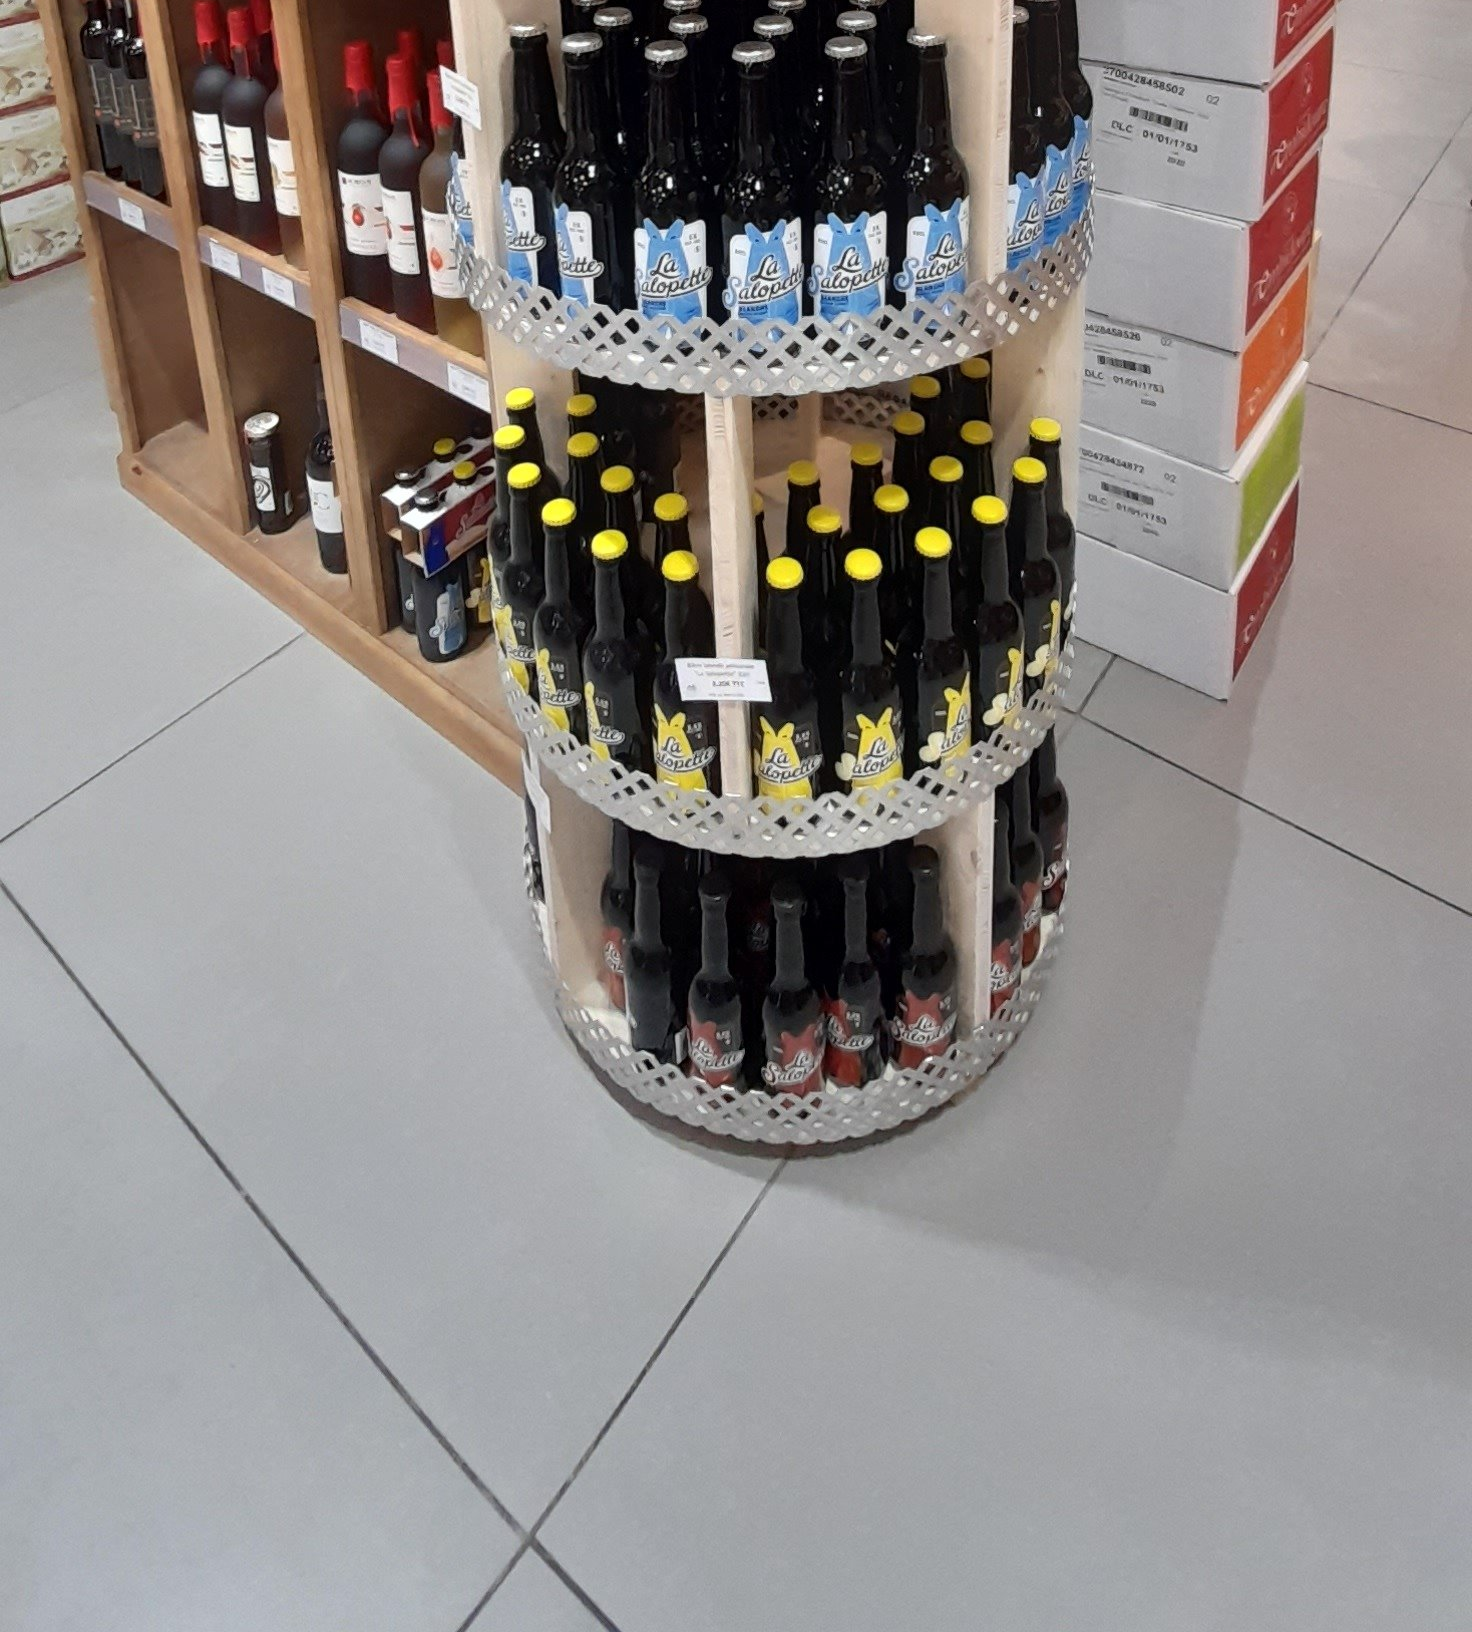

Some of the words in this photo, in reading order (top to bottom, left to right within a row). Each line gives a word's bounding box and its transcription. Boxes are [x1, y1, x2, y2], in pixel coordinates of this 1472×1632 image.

[1111, 120, 1133, 134] DLC
[918, 232, 956, 262] La
[651, 252, 682, 279] La
[751, 254, 781, 282] La
[832, 246, 861, 273] La
[661, 737, 686, 759] La
[765, 748, 792, 769] La
[865, 737, 889, 760] La
[914, 1016, 941, 1031] La
[792, 1052, 815, 1070] La
